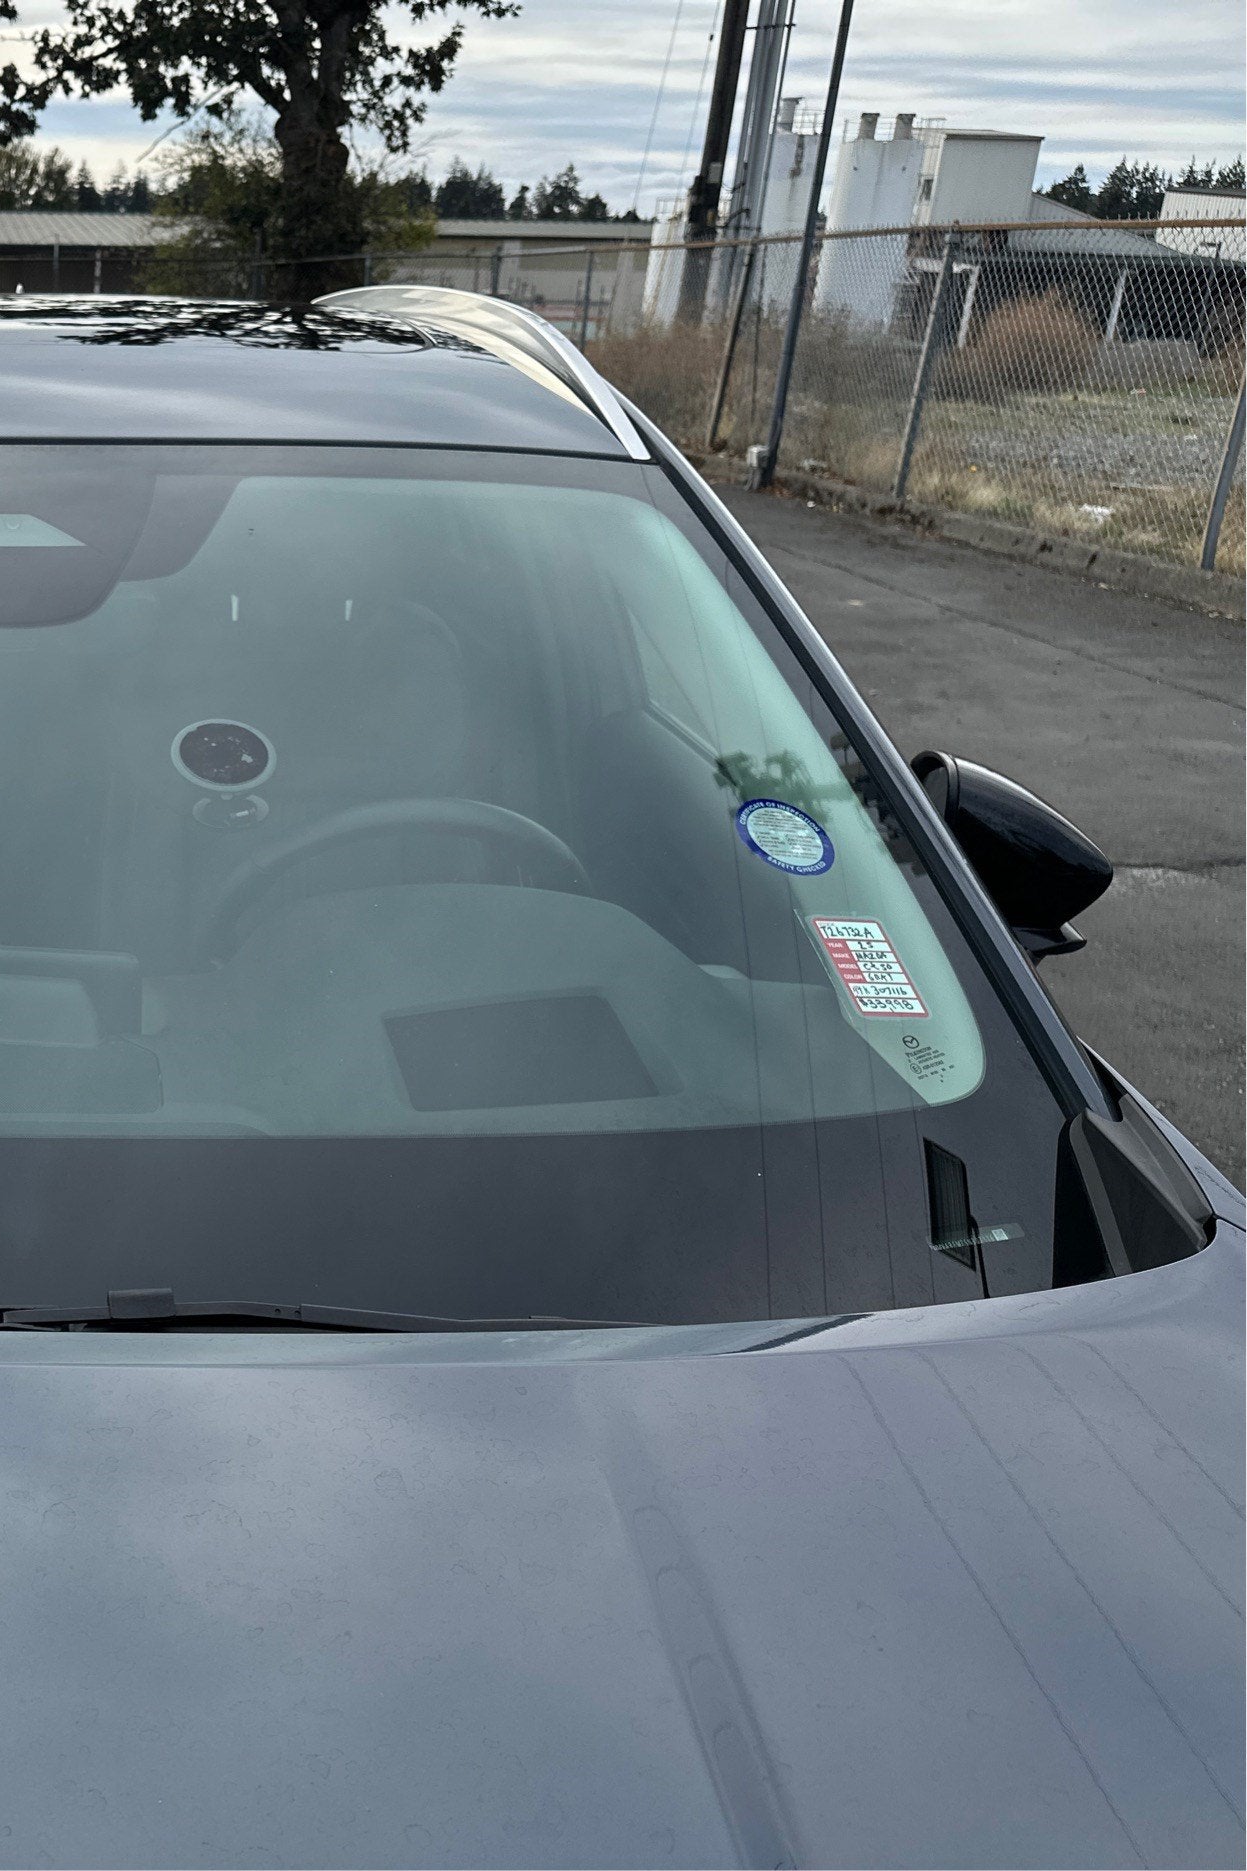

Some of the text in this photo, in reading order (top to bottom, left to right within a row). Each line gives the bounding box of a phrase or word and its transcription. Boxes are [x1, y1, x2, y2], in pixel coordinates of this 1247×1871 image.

[777, 803, 820, 832] INSPECTION
[767, 856, 826, 873] SAFETY CHECKED
[820, 926, 874, 939] T26732A
